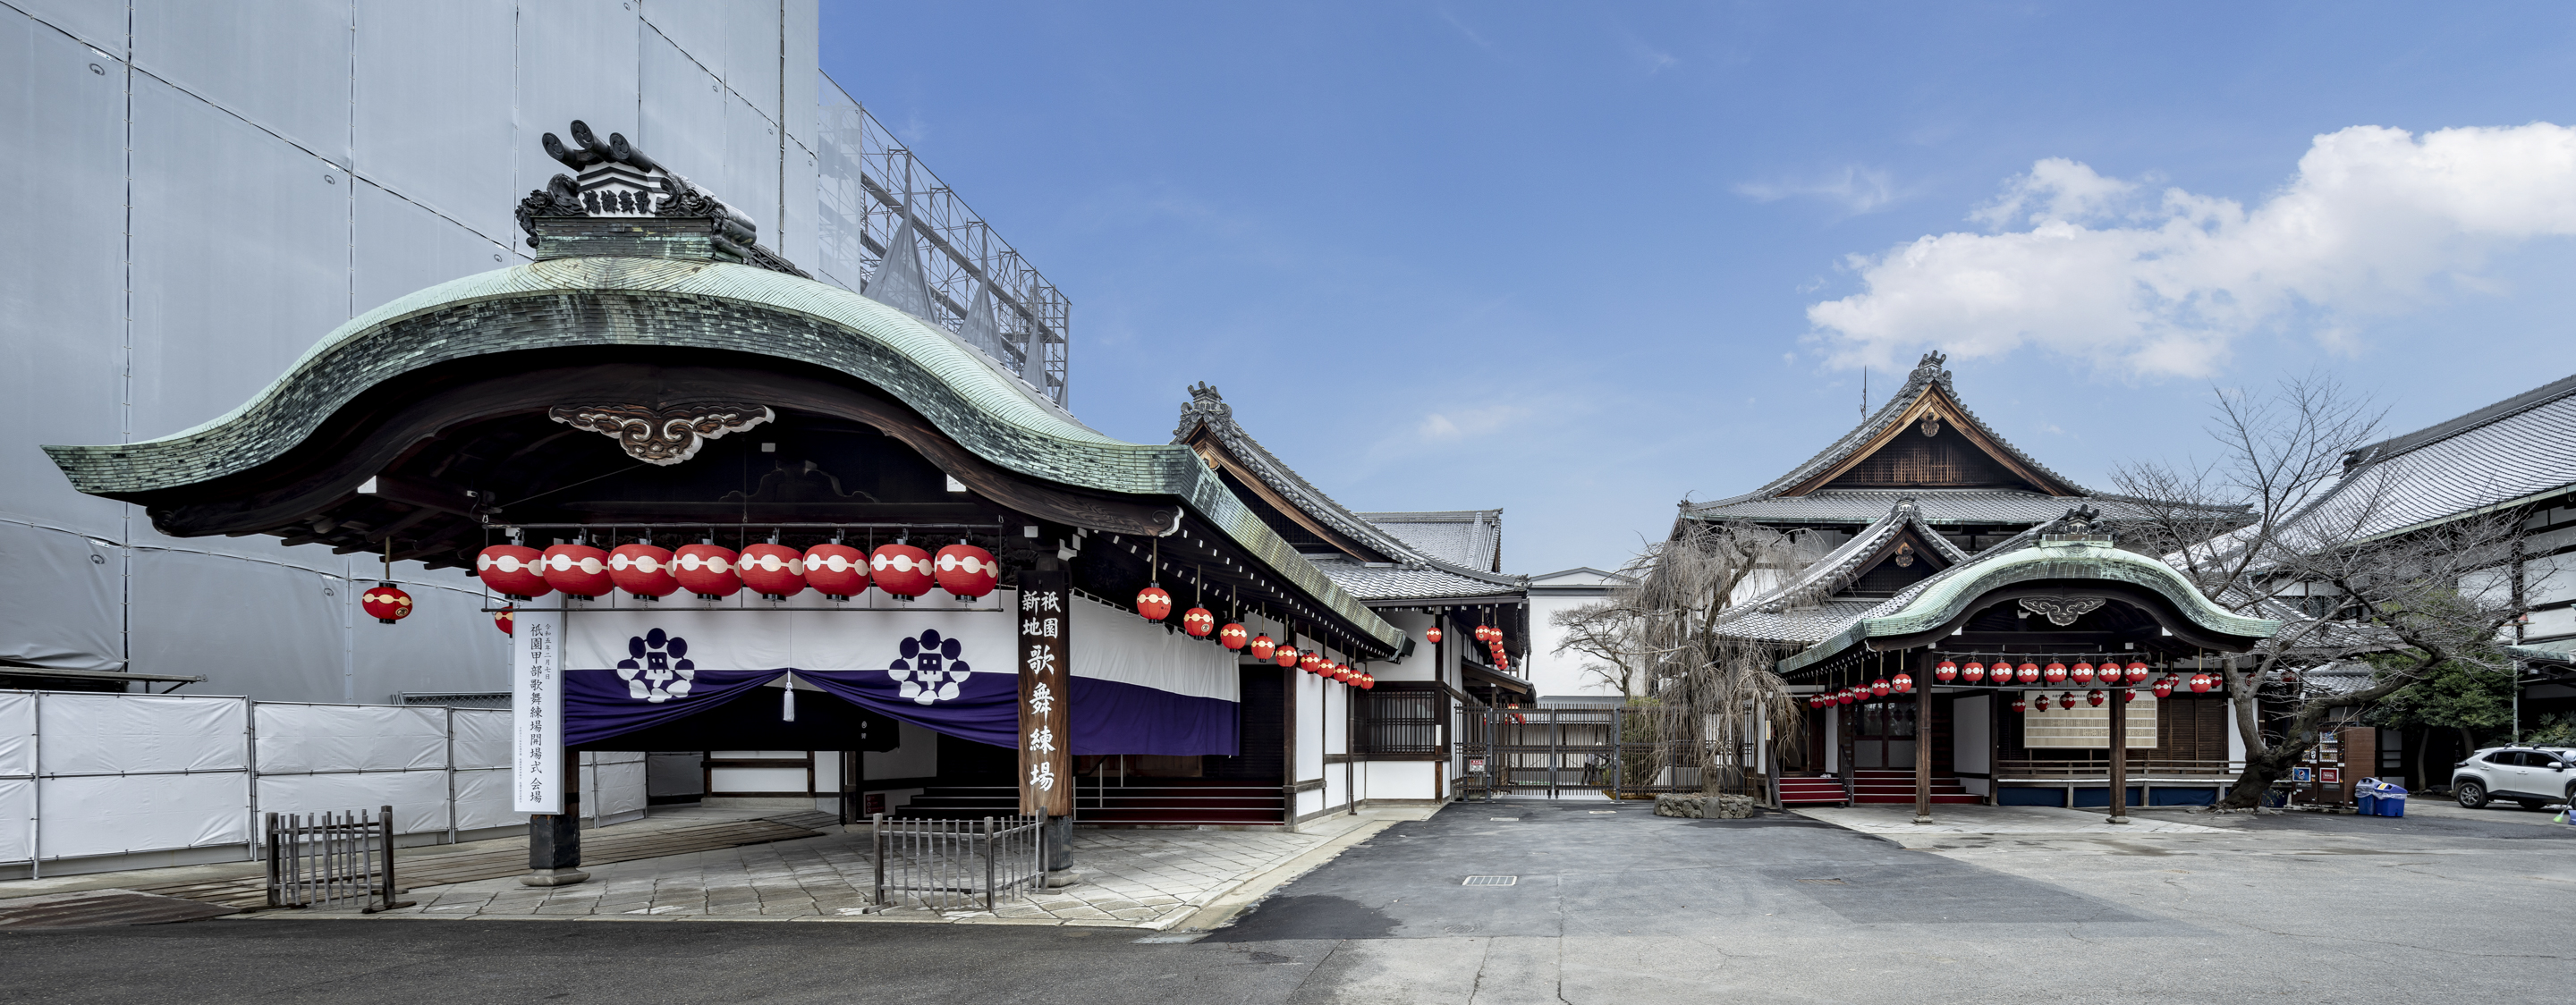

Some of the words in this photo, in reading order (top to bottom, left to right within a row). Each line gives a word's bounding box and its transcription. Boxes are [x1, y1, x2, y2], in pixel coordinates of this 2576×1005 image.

[1021, 590, 1043, 636] 新地
[1040, 591, 1061, 638] 祇園
[544, 623, 552, 680] 令和五年二月七日
[530, 623, 544, 774] 祇園甲部歌舞練場開場式
[1027, 645, 1056, 792] 歌舞練場
[530, 777, 543, 803] 会場
